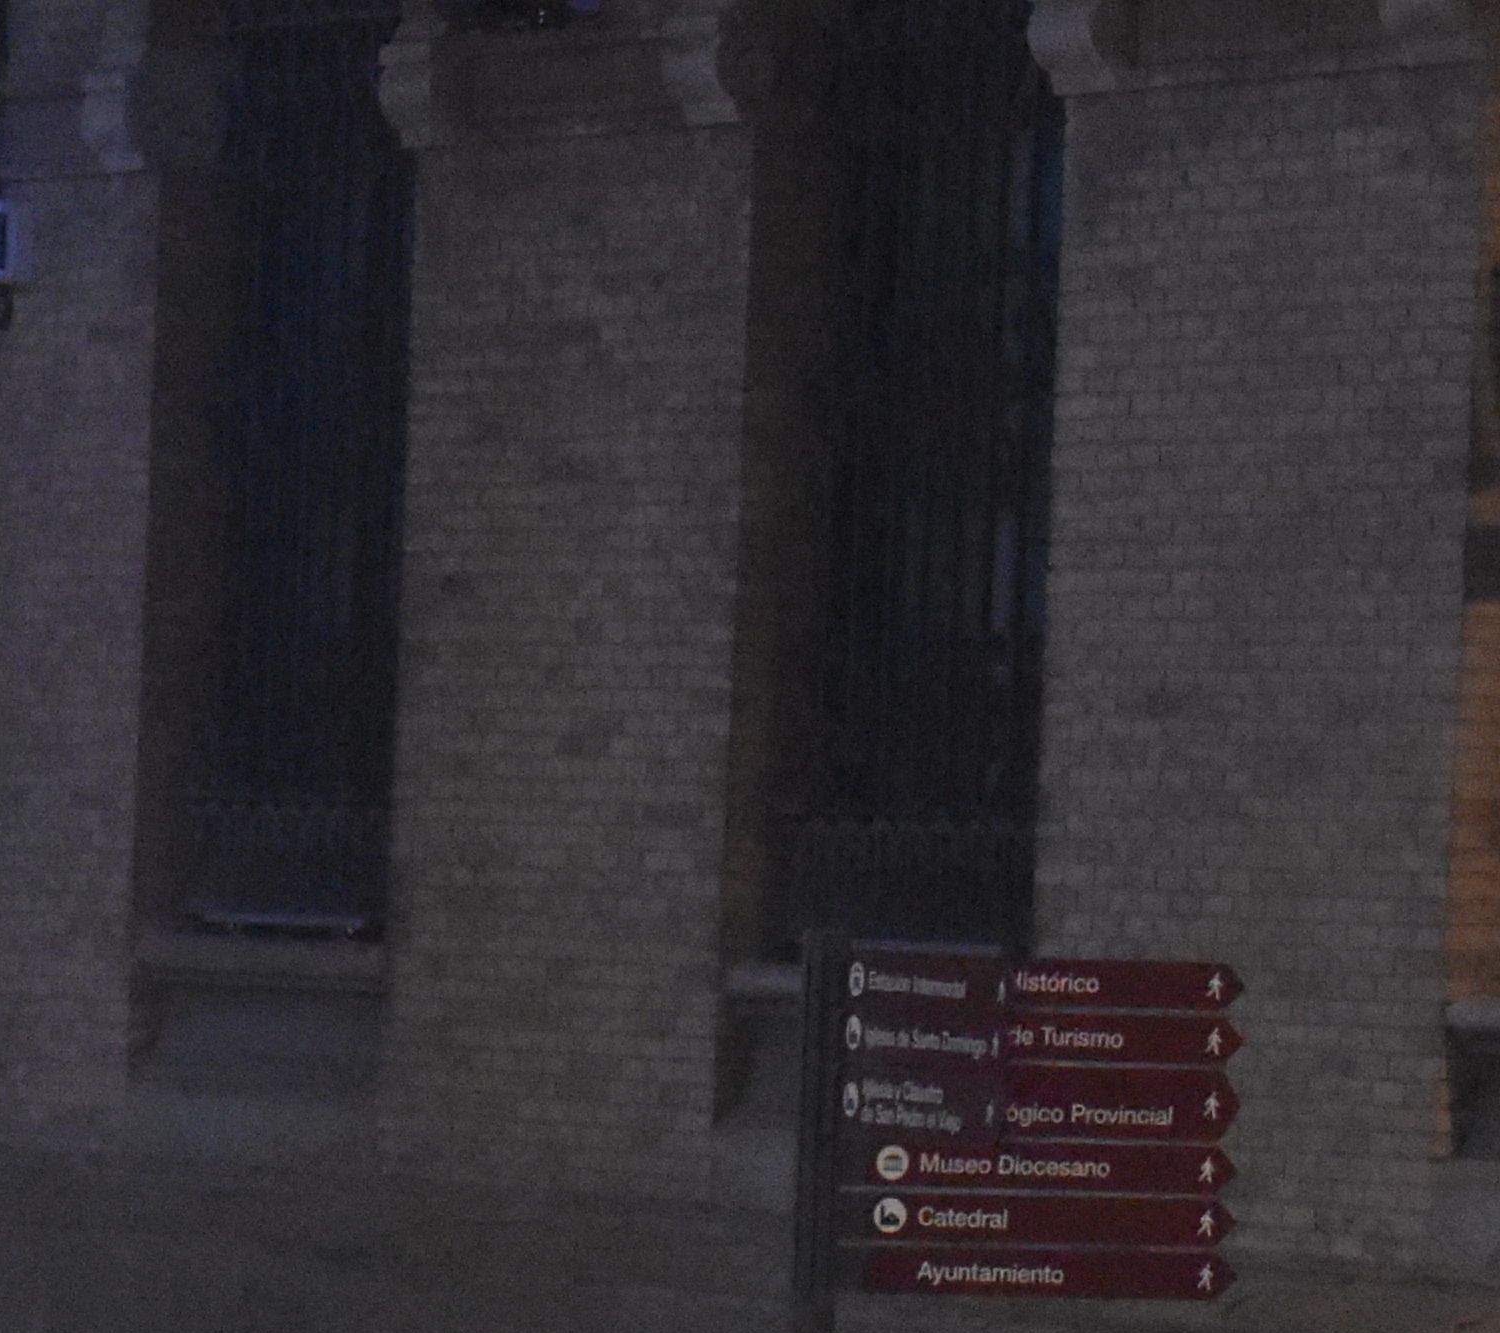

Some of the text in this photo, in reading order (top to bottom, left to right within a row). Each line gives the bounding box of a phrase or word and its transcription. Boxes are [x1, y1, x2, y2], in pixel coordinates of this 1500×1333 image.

[1016, 971, 1100, 993] istórico
[1041, 1026, 1124, 1049] Turismo
[1070, 1103, 1174, 1126] Provincial
[919, 1152, 1111, 1178] Museo Diocesano
[917, 1206, 1010, 1229] Catedral
[916, 1261, 1065, 1285] Ayuntamiento
